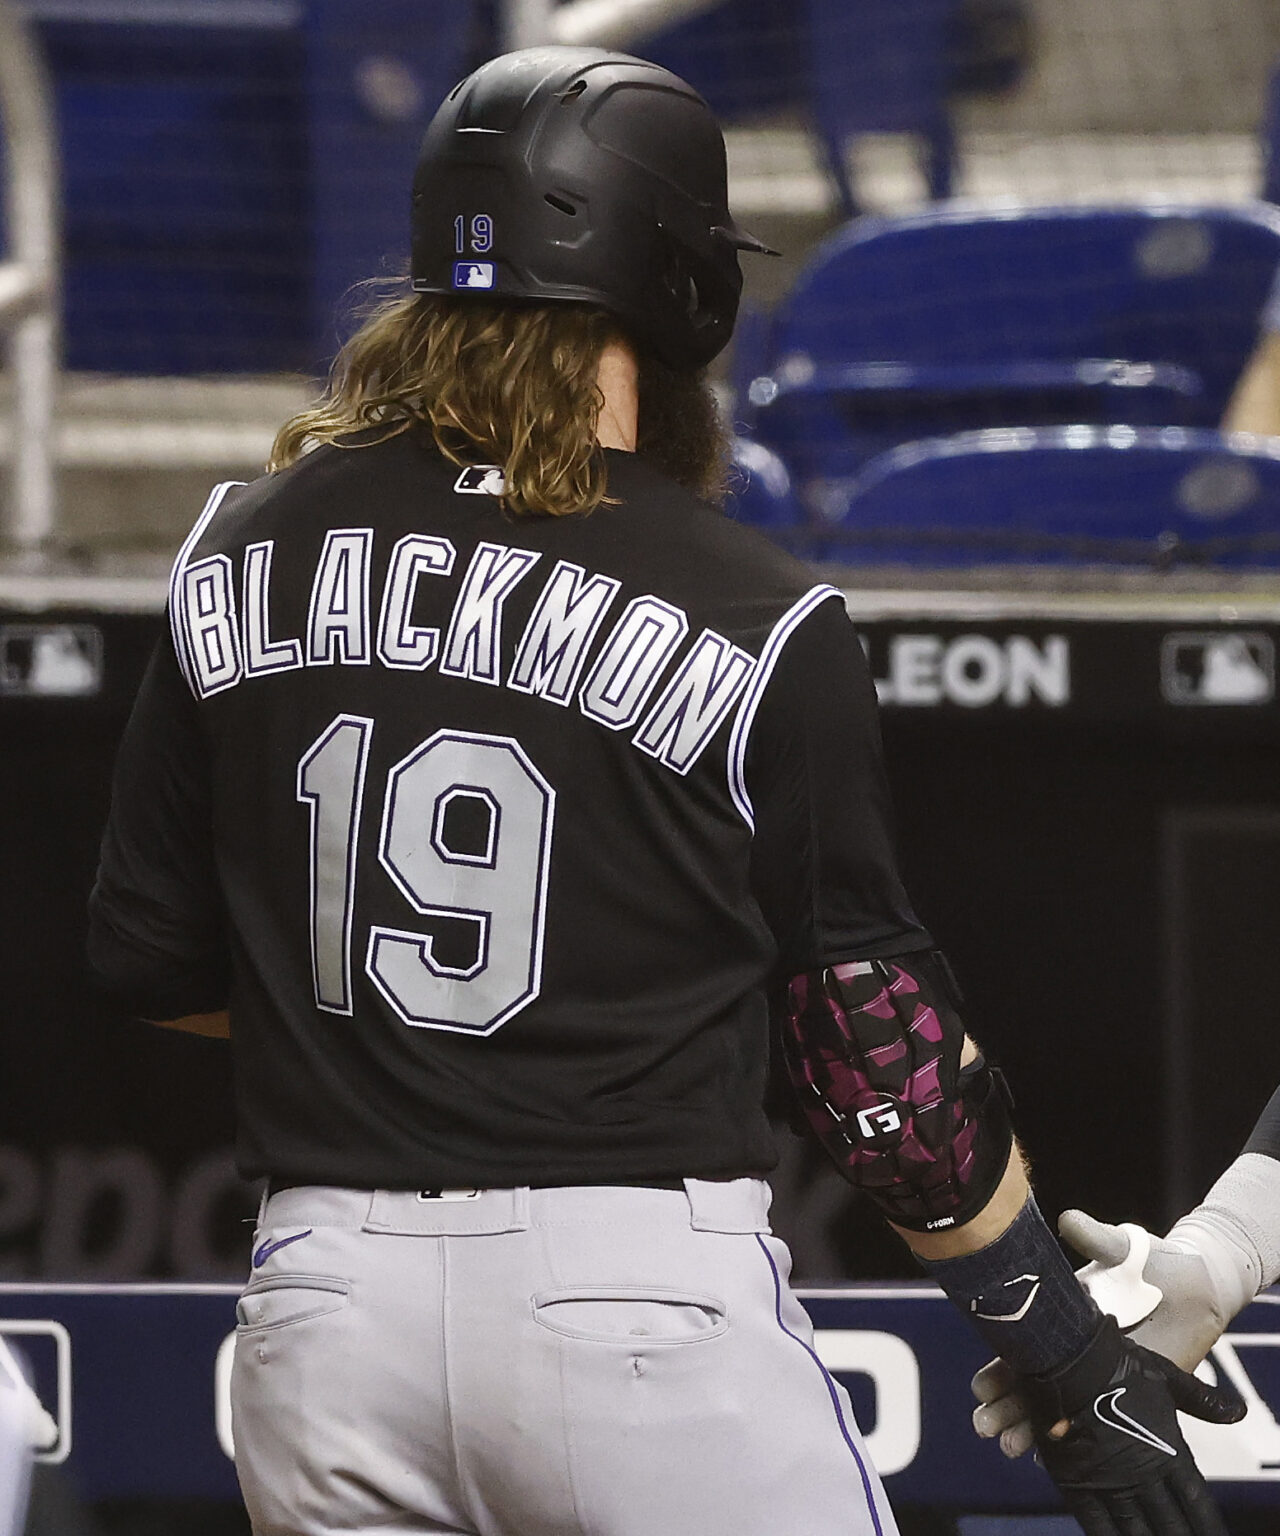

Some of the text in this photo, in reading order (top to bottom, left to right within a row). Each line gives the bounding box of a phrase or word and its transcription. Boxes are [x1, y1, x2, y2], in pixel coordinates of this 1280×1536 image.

[454, 214, 493, 253] 19
[180, 527, 759, 776] BLACKMON
[297, 714, 557, 1037] 19
[926, 1216, 955, 1230] G-FORM
